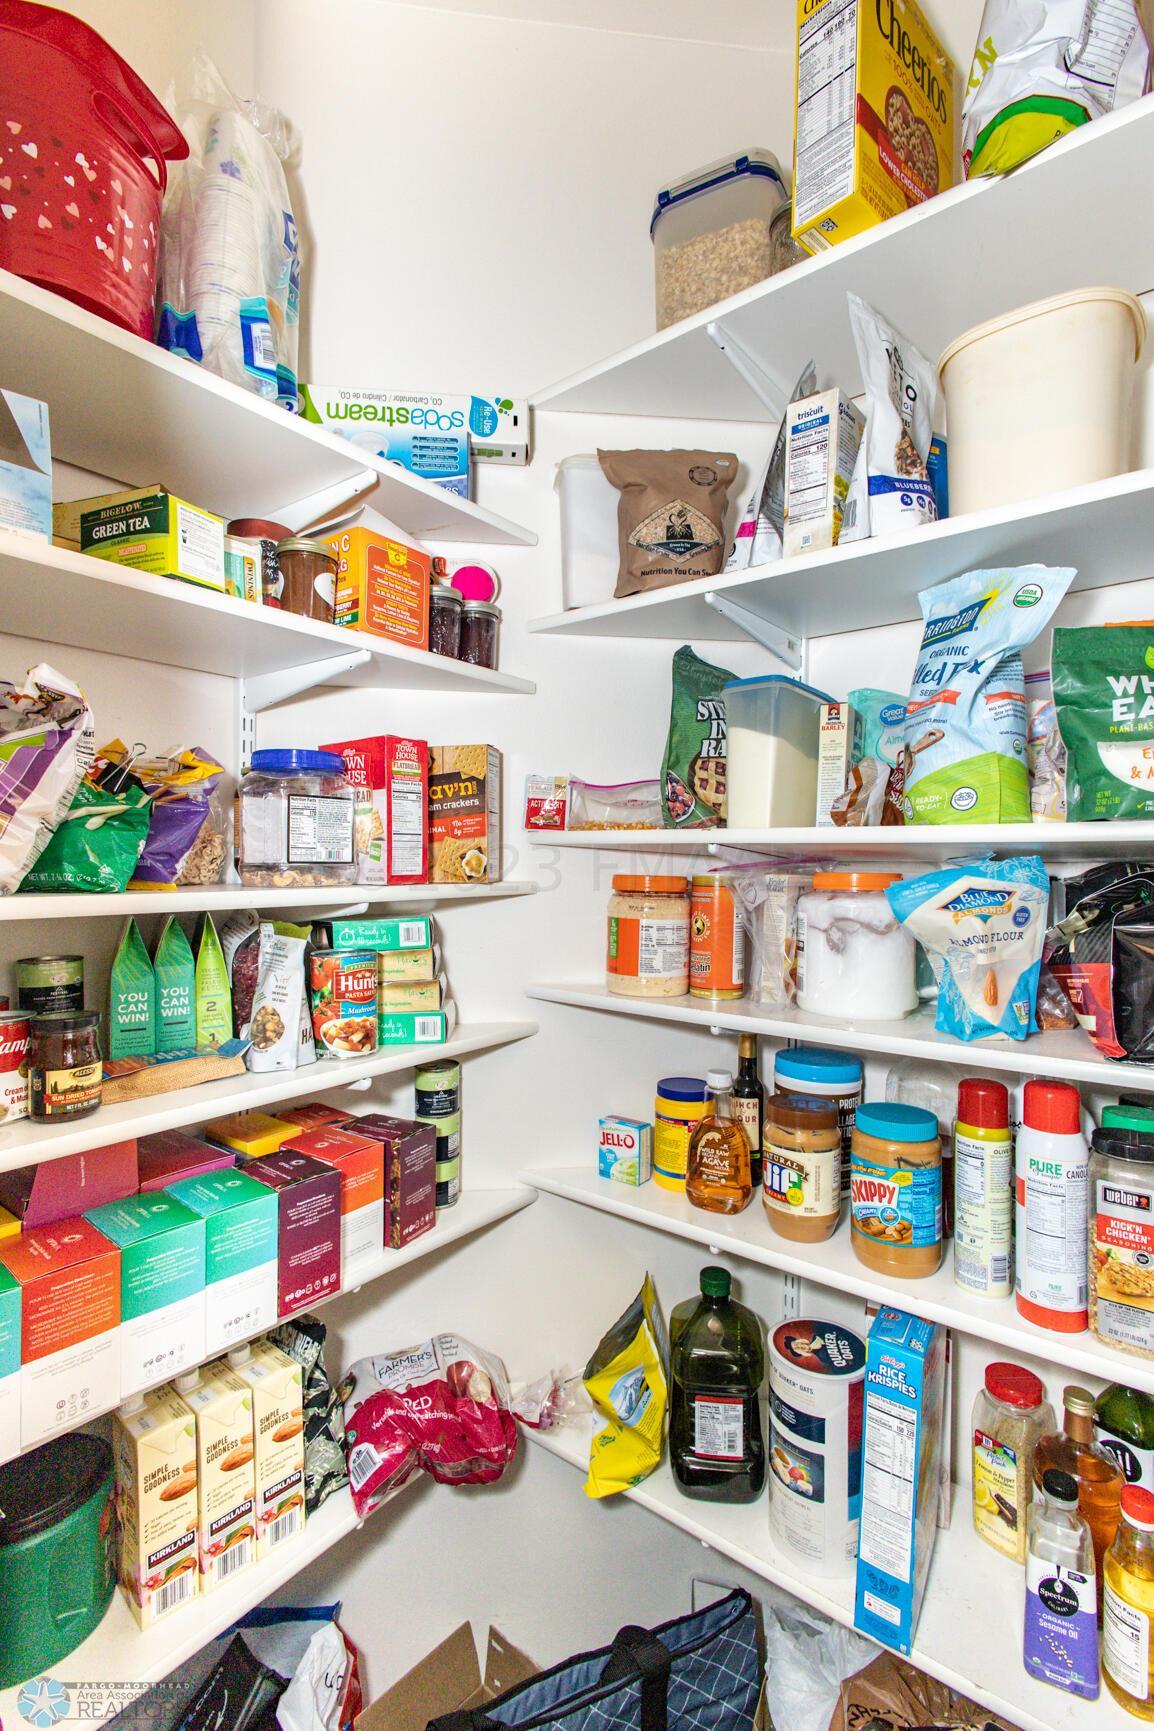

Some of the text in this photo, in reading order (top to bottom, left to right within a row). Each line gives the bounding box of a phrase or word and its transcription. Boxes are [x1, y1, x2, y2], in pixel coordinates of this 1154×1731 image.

[876, 0, 947, 124] Cheerios
[879, 146, 903, 177] LOWER
[352, 392, 430, 405] Carbonator Cilindro de
[326, 402, 465, 431] sodastream
[482, 405, 492, 435] Re-Use
[797, 405, 824, 421] triscuit
[791, 428, 829, 442] Nutrition Facts
[790, 442, 828, 460] Calories 120
[100, 501, 143, 520] BIGELOW
[92, 516, 151, 540] GREEN TEA
[245, 561, 254, 600] TWININGS
[641, 567, 701, 577] Nutrition You Can
[1022, 588, 1037, 596] USDA
[929, 645, 970, 659] ORGANIC
[881, 708, 904, 718] Great
[887, 714, 904, 722] Value
[395, 751, 419, 762] HOUSE
[396, 744, 418, 754] TOWN
[343, 754, 365, 769] OWN
[393, 761, 421, 770] FLATBREAD
[442, 798, 480, 811] crackers
[948, 892, 1009, 912] DIAMOND
[960, 890, 990, 903] BLUE
[957, 906, 1009, 919] ALMONDS
[358, 926, 387, 936] Ready in
[948, 931, 1024, 948] ALMOND FLOUR
[350, 962, 377, 971] PREMIU
[161, 986, 189, 998] YOU
[341, 974, 378, 992] Hunt's
[118, 991, 148, 1003] YOU
[160, 997, 189, 1008] CAN
[345, 991, 363, 999] PASTA
[118, 1002, 148, 1014] CAN
[161, 1007, 191, 1018] WIN!
[206, 1001, 217, 1013] 2
[117, 1013, 150, 1025] WIN!
[0, 1035, 30, 1055] amp
[4, 1086, 24, 1097] Cream
[66, 1092, 85, 1100] DRIED
[716, 1149, 730, 1157] RAW
[764, 1151, 800, 1170] ATURAL
[993, 1148, 1010, 1156] OLIVE
[702, 1158, 730, 1168] AGAVE
[1029, 1158, 1063, 1176] PURE
[763, 1161, 800, 1194] Jif
[851, 1179, 896, 1205] SKIPPY
[1106, 1188, 1139, 1207] weber
[1110, 1219, 1143, 1234] KICK'N
[1101, 1235, 1153, 1252] SEASONING
[1105, 1227, 1148, 1245] CHICKEN
[824, 1332, 848, 1368] QUAKER
[837, 1339, 855, 1360] OATS
[378, 1350, 433, 1379] FARMER'S
[388, 1361, 425, 1380] PROMISE
[879, 1364, 906, 1384] RICE
[867, 1371, 918, 1399] KRISPIES
[403, 1395, 433, 1411] RED
[259, 1408, 280, 1427] SIMPLE
[395, 1408, 407, 1417] and
[259, 1412, 290, 1436] GOODNESS
[206, 1434, 229, 1456] SIMPLE
[206, 1439, 239, 1465] GOODNESS
[143, 1463, 169, 1485] SIMPLE
[143, 1467, 181, 1494] GOODNESS
[975, 1459, 993, 1475] Lemon
[998, 1472, 1015, 1486] Pepper
[265, 1472, 302, 1500] KIRKLAND
[212, 1502, 252, 1532] KIRKLAND
[149, 1532, 194, 1563] KIRKLAND
[1039, 1586, 1078, 1608] Spectrum
[1039, 1618, 1078, 1640] Sesame Oil
[1041, 1613, 1075, 1631] ORGANIC
